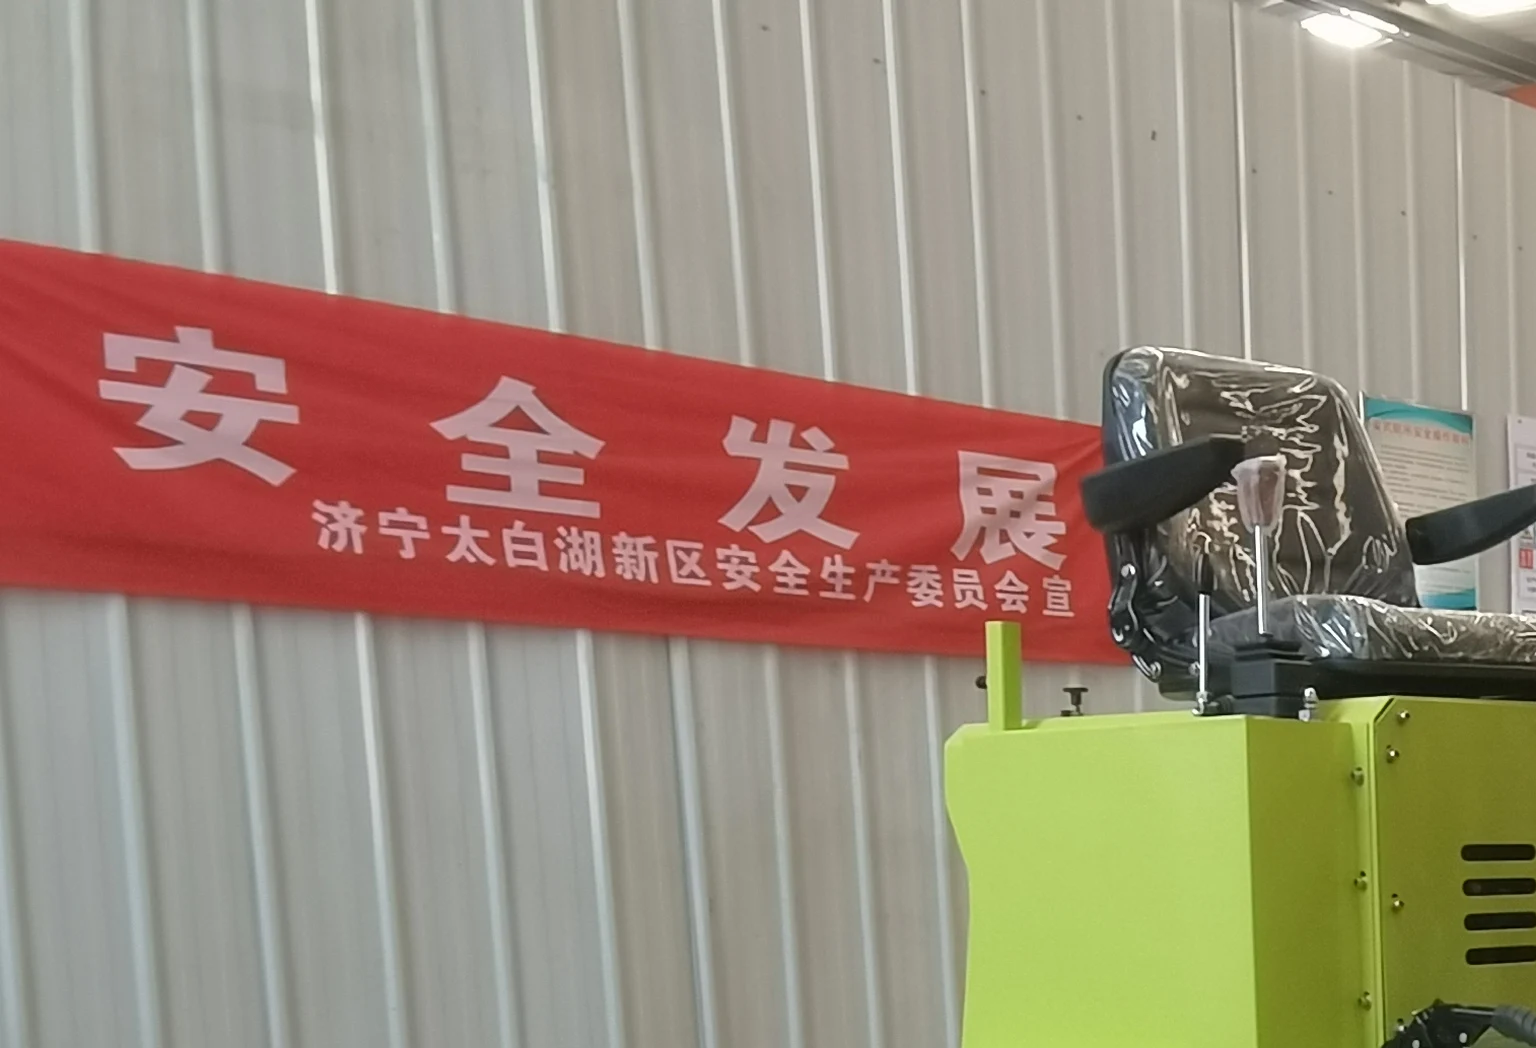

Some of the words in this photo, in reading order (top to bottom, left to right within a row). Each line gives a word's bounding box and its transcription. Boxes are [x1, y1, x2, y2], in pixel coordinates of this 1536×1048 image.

[98, 326, 1067, 569] 安全发展
[311, 499, 1074, 617] 济宁太白湖新区安全生产委员会宣
